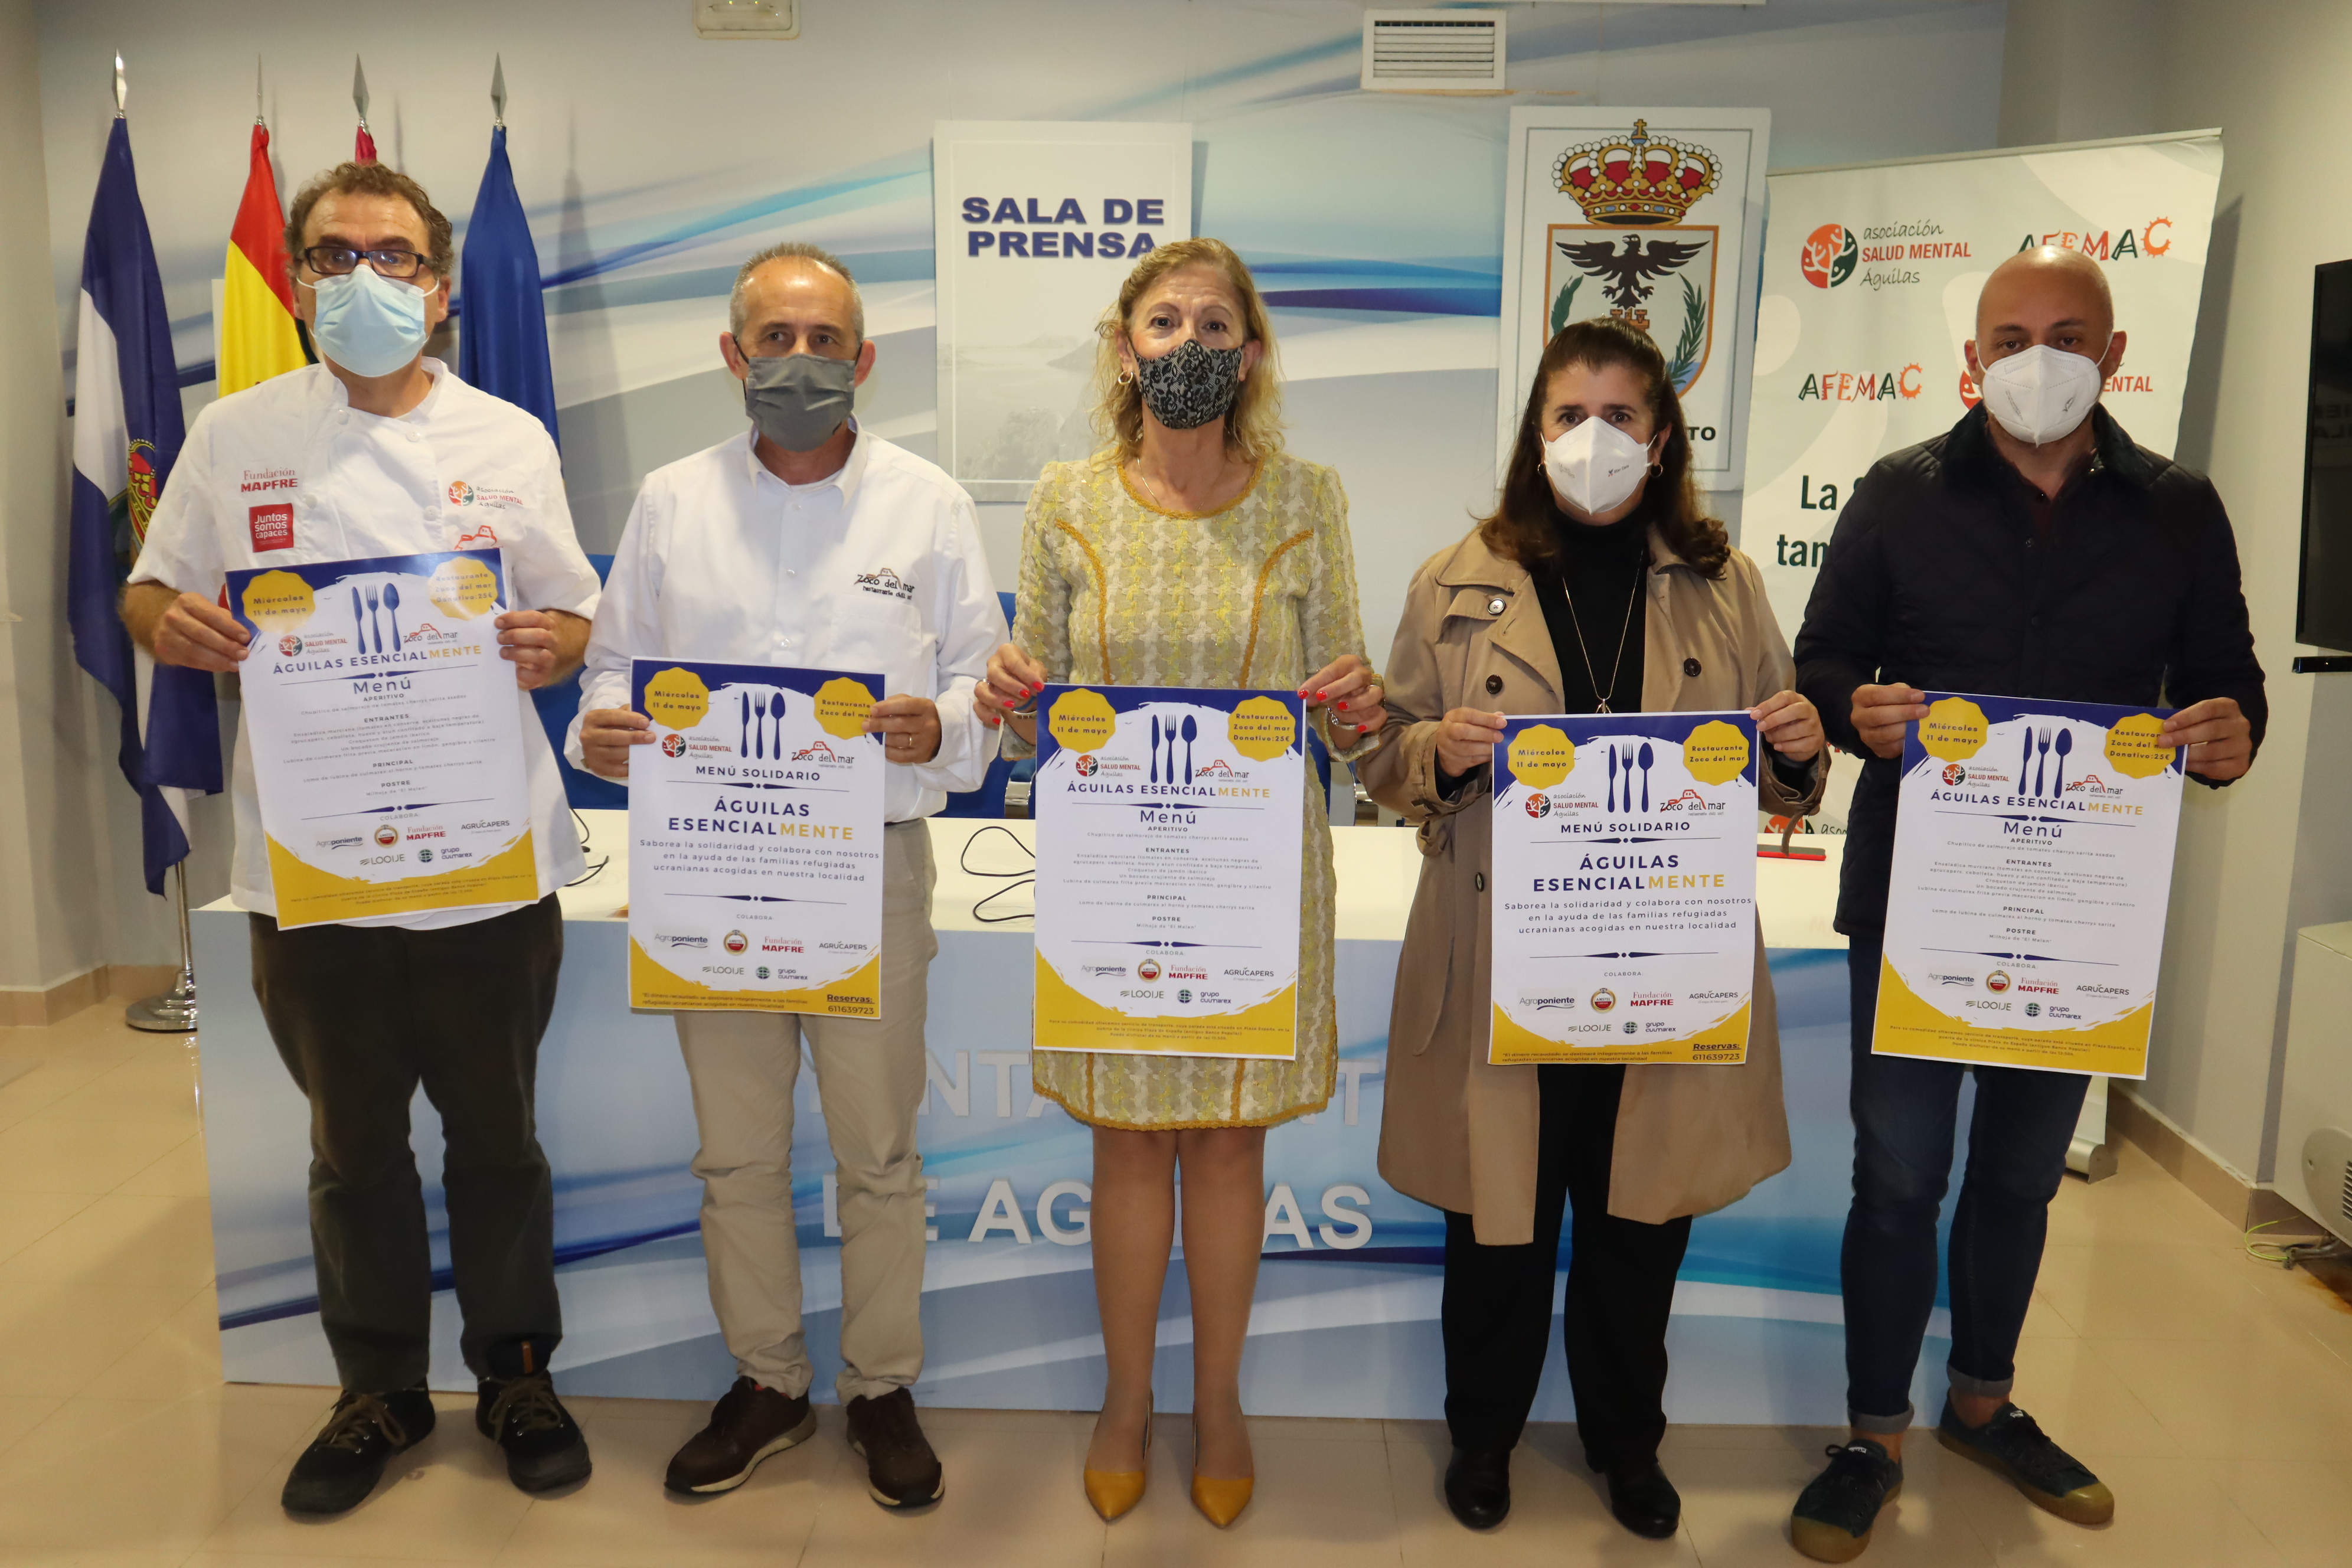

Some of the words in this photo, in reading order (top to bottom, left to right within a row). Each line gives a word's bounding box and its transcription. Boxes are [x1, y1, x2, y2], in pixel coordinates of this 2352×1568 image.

[962, 197, 1087, 224] SALA
[1103, 199, 1165, 225] DE
[1864, 219, 1944, 240] asociación
[968, 231, 1155, 259] PRENSA
[1862, 245, 1904, 262] SALUD
[1909, 242, 1971, 259] MENTAL
[1860, 267, 1920, 290] Águilas
[1798, 362, 1923, 402] AFEMAC
[2103, 375, 2153, 392] ENTAL
[243, 467, 295, 481] Fundación
[241, 478, 298, 492] MAPFRE
[1801, 475, 1837, 510] La
[499, 495, 523, 505] MENTAL
[254, 513, 288, 524] Juntos
[254, 522, 287, 532] somos
[256, 530, 288, 540] capaces
[857, 574, 880, 586] Zoco
[884, 579, 897, 589] del
[903, 583, 915, 593] mar
[253, 594, 303, 604] Miércoles
[273, 658, 343, 674] ÁGUILAS
[350, 645, 481, 666] ESENCIALMENTE
[353, 677, 410, 694] Menú
[363, 693, 404, 701] APERITIVO
[654, 690, 700, 698] Miércoles
[364, 714, 409, 723] ENTRANTES
[1929, 722, 1977, 731] Miércoles
[2109, 750, 2170, 760] Donativo:25€
[373, 759, 413, 767] PRINCIPAL
[696, 765, 735, 776] MENÚ
[742, 768, 819, 780] SOLIDARIO
[1067, 780, 1133, 793] ÁGUILAS
[1141, 783, 1270, 796] ESENCIALMENTE
[714, 795, 809, 816] ÁGUILAS
[1660, 803, 1683, 812] Zoco
[1688, 802, 1701, 810] del
[1930, 789, 2000, 804] ÁGUILAS
[2007, 796, 2143, 814] ESENCIALMENTE
[1140, 808, 1195, 824] Menú
[669, 817, 852, 839] ESENCIALMENTE
[1561, 821, 1602, 833] MENÚ
[1609, 822, 1690, 832] SOLIDARIO
[2004, 821, 2062, 837] Menú
[406, 831, 445, 840] MAPFRE
[1579, 853, 1678, 870] ÁGUILAS
[1534, 875, 1724, 891] ESENCIALMENTE
[2003, 906, 2043, 914] PRINCIPAL
[1558, 913, 1587, 922] ayuda
[1672, 910, 1726, 918] refugiadas
[1579, 924, 1624, 932] acogidas
[762, 945, 803, 953] MAPFRE
[2021, 977, 2057, 986] Fundación
[1131, 989, 1164, 998] LOOIJE
[2018, 985, 2059, 994] MAPFRE
[2076, 985, 2129, 995] AGRUCAPERS
[827, 994, 874, 1003] Reservas:
[1520, 997, 1574, 1005] Agroponiente
[828, 1005, 874, 1014] 611639723
[1977, 1001, 2011, 1011] LOOIJE
